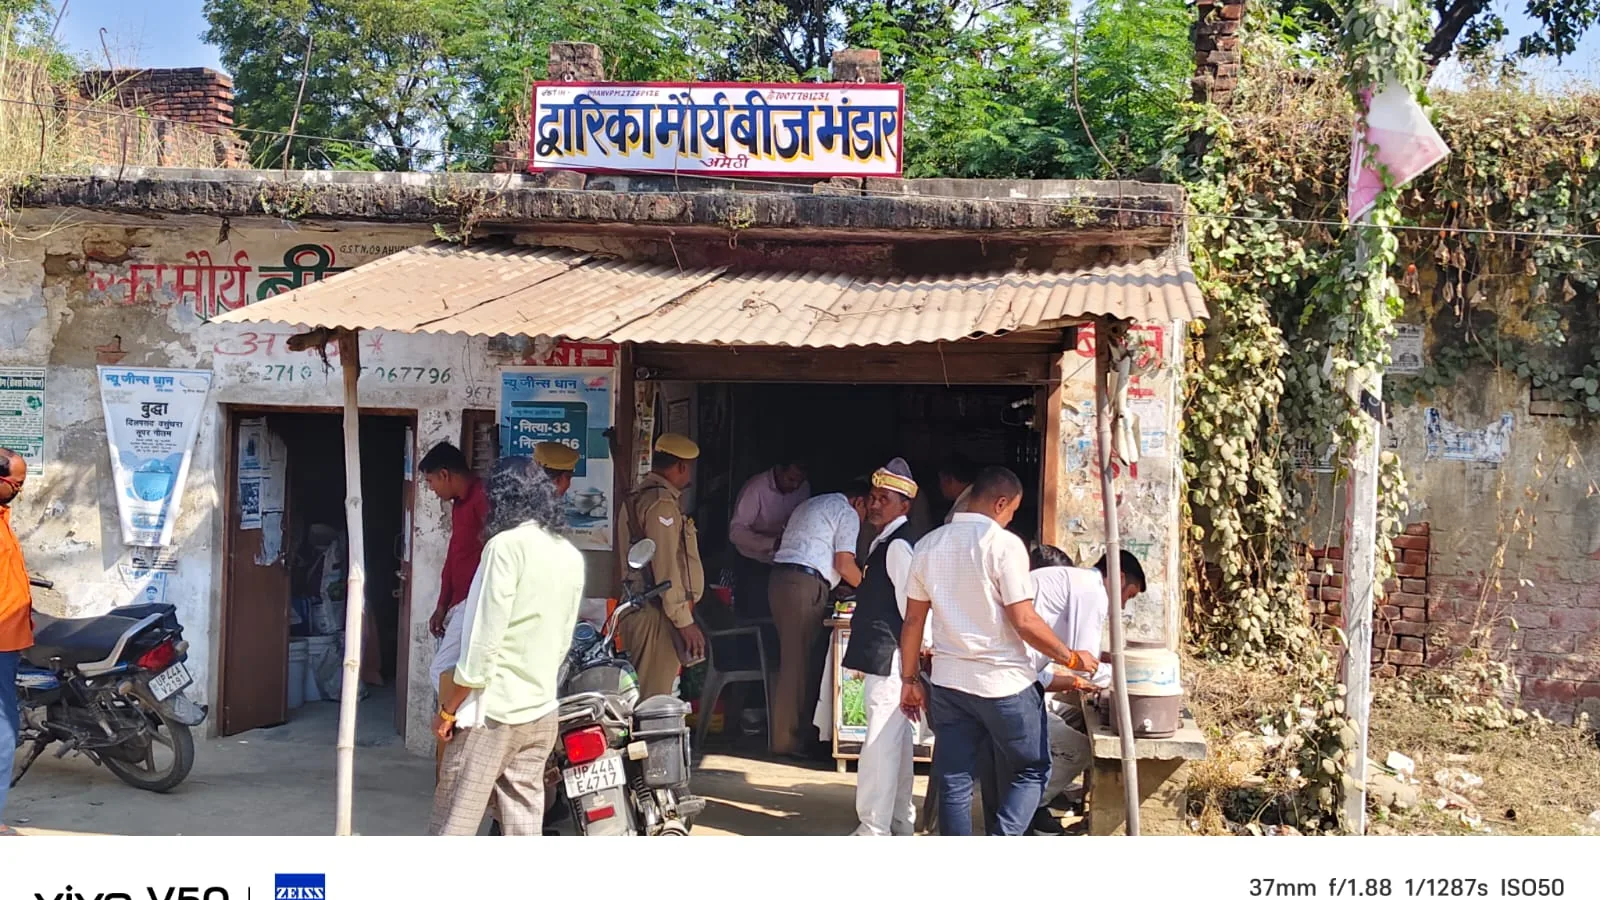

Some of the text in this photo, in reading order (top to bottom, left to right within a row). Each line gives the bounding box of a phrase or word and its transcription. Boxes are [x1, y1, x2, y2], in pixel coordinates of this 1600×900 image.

[536, 90, 898, 160] द्वारिका मौर्य बीज भंडार
[699, 155, 749, 169] अमेठी
[573, 759, 615, 780] UP44A
[576, 772, 616, 793] E4717
